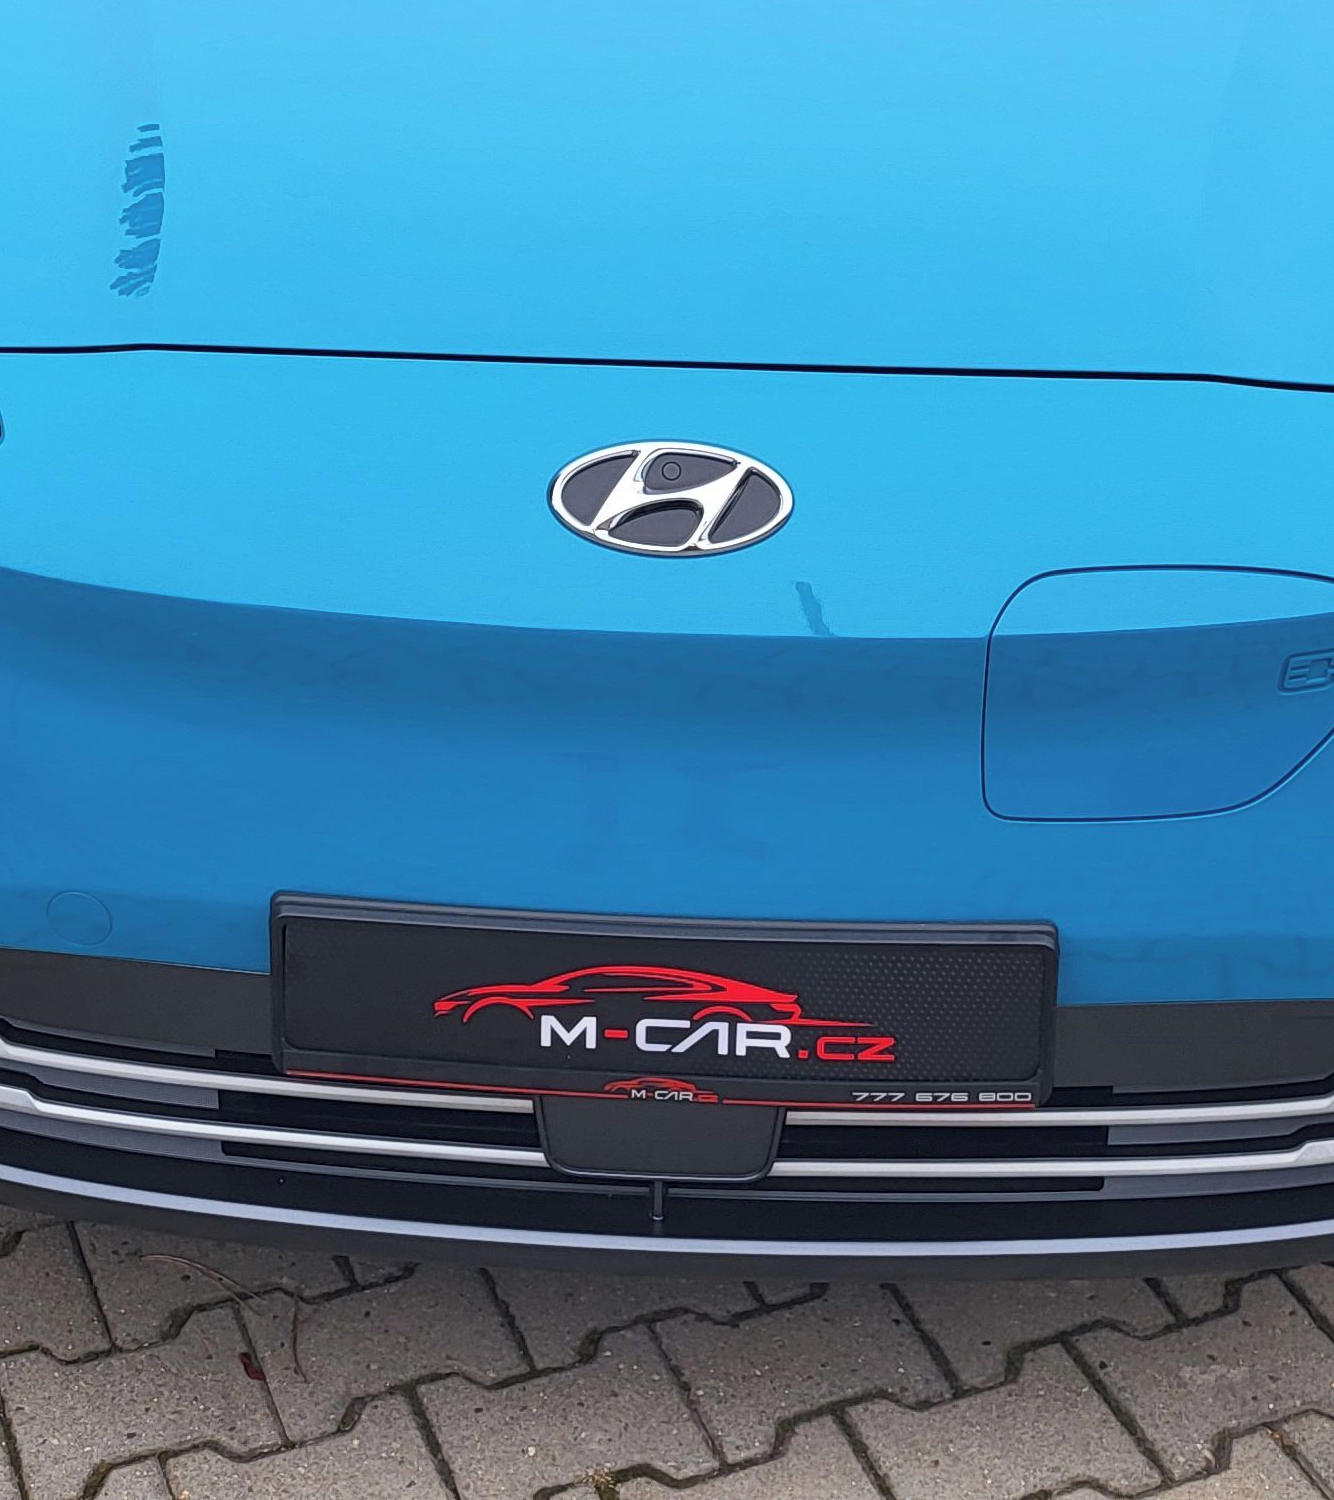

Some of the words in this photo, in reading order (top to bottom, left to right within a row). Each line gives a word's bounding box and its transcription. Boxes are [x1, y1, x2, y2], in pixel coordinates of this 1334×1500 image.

[540, 1015, 896, 1062] M-CAR.cz
[852, 1092, 905, 1102] 777
[915, 1092, 968, 1102] 676
[978, 1092, 1032, 1102] 800
